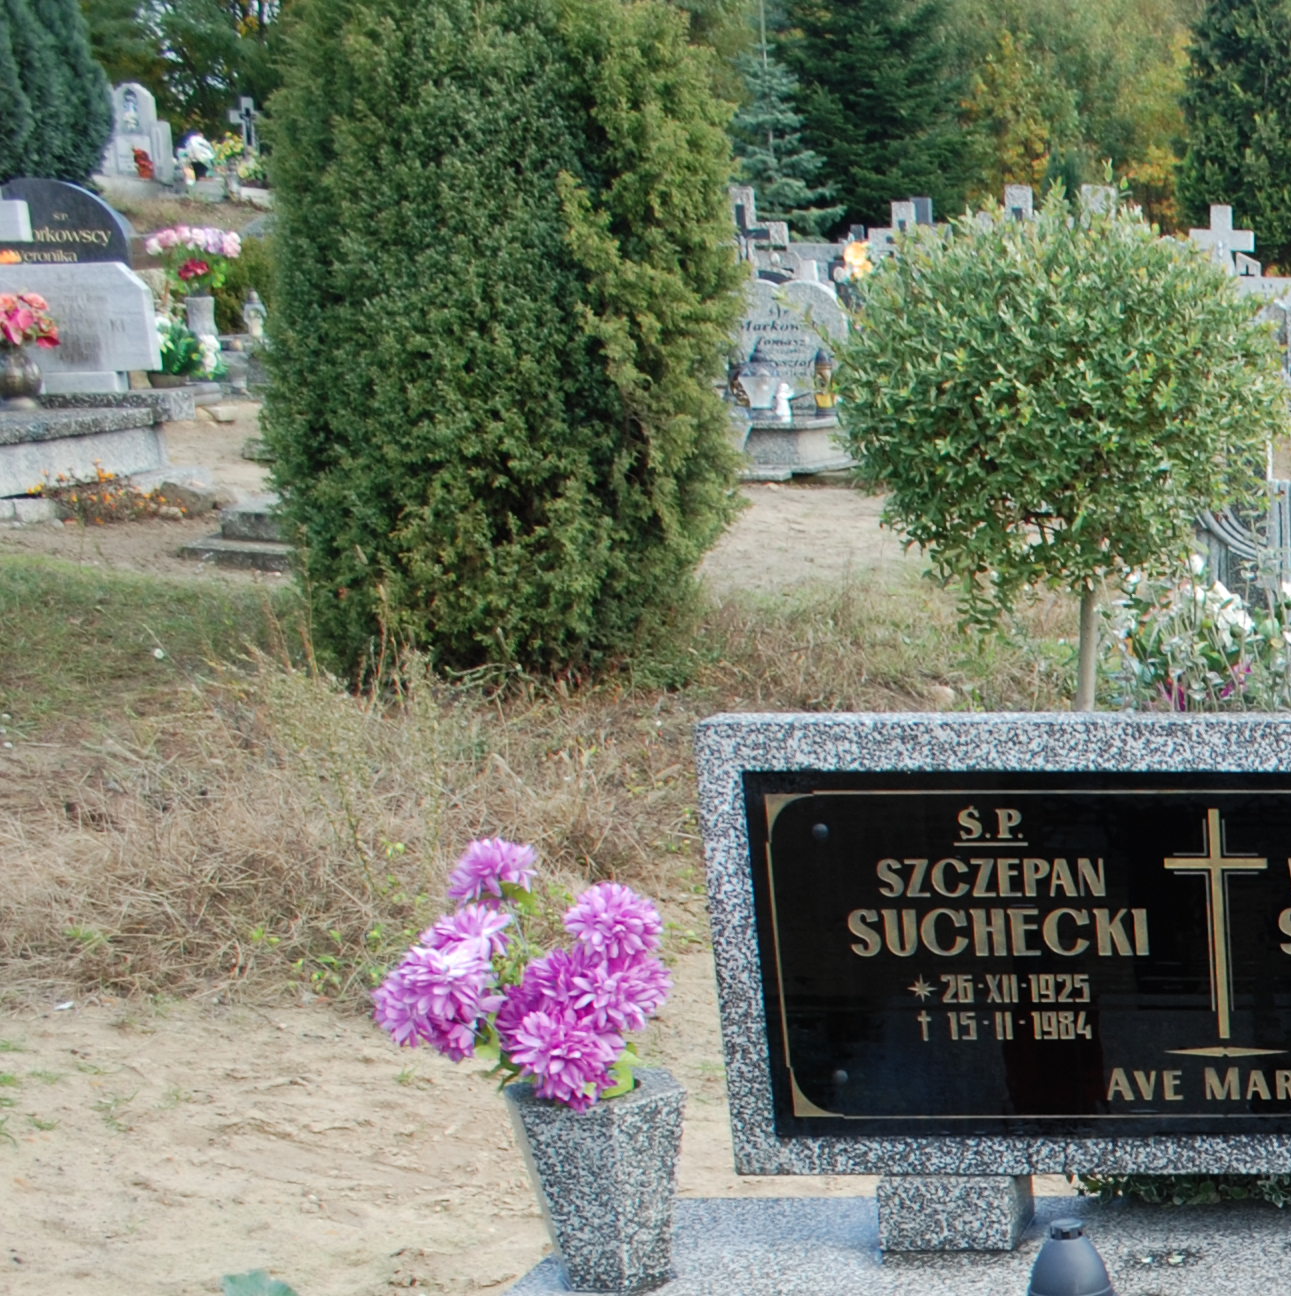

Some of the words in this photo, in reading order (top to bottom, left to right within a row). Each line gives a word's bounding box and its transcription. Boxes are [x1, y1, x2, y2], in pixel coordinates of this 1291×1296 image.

[876, 858, 1107, 898] SZCZEPAN
[846, 907, 1151, 957] SUCHECKI
[1106, 1067, 1185, 1102] AVE
